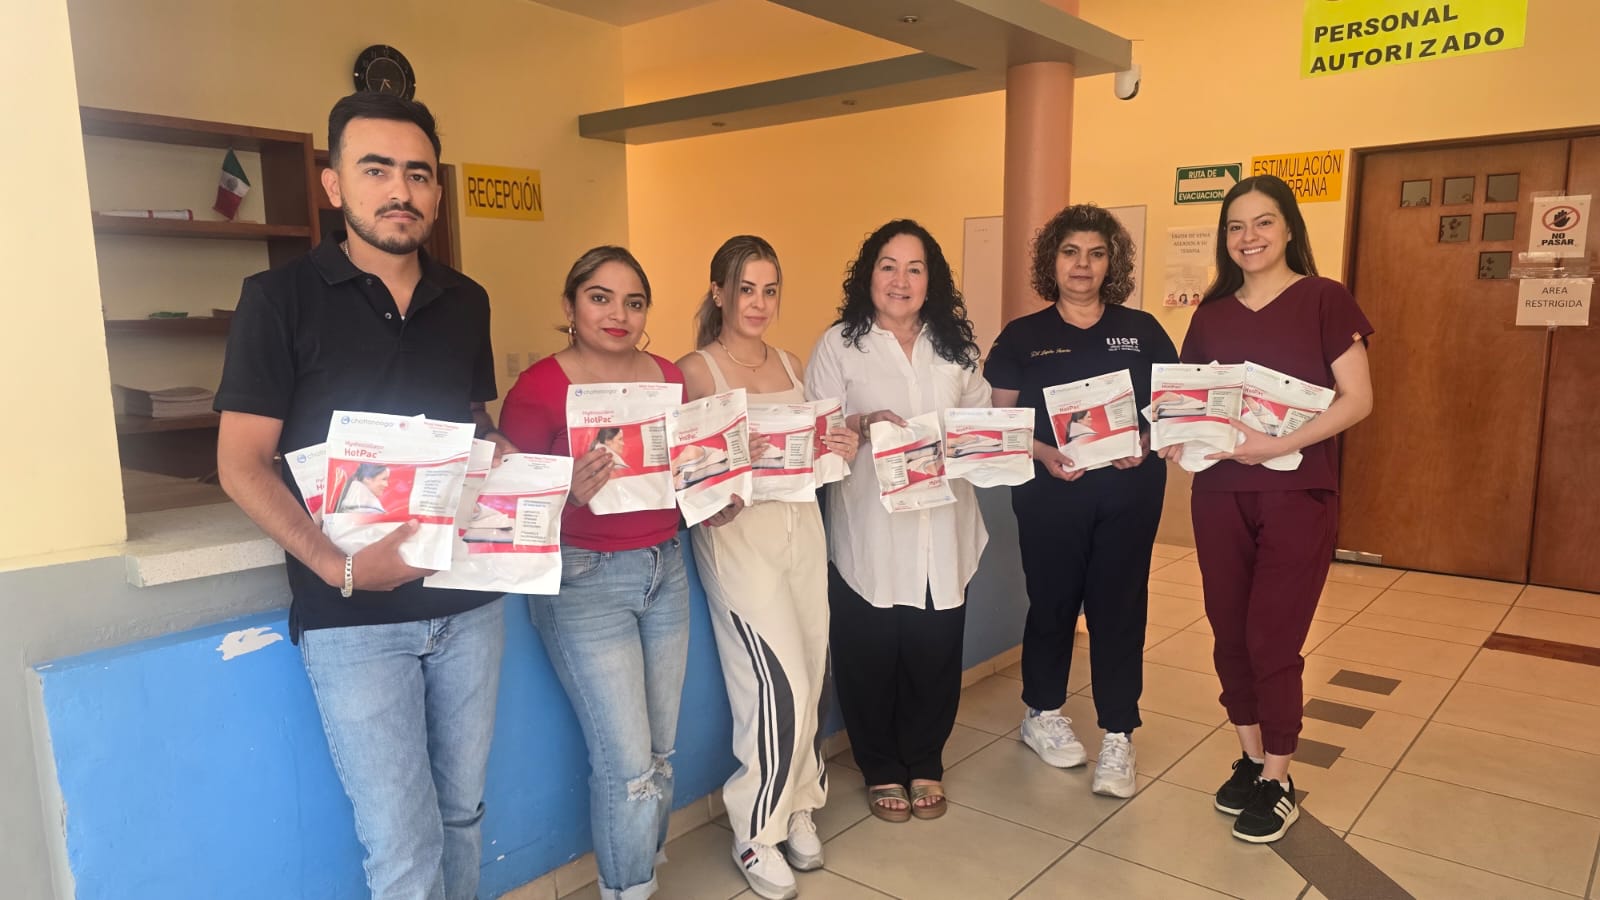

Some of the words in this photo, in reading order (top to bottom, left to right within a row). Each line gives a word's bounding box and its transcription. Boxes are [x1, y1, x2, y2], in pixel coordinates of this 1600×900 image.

[1313, 4, 1459, 43] PERSONAL
[1310, 27, 1505, 74] AUTORIZADO
[1253, 151, 1342, 177] ESTIMULACIÓN
[1188, 170, 1206, 179] RUTA
[1207, 169, 1217, 178] DE
[467, 176, 542, 212] RECEPCIÓN
[1285, 176, 1328, 198] PRANA
[1178, 191, 1224, 201] EVACUACION
[1542, 286, 1568, 295] AREA
[1525, 299, 1583, 308] RESTRIGIDA
[344, 448, 378, 459] HotPac
